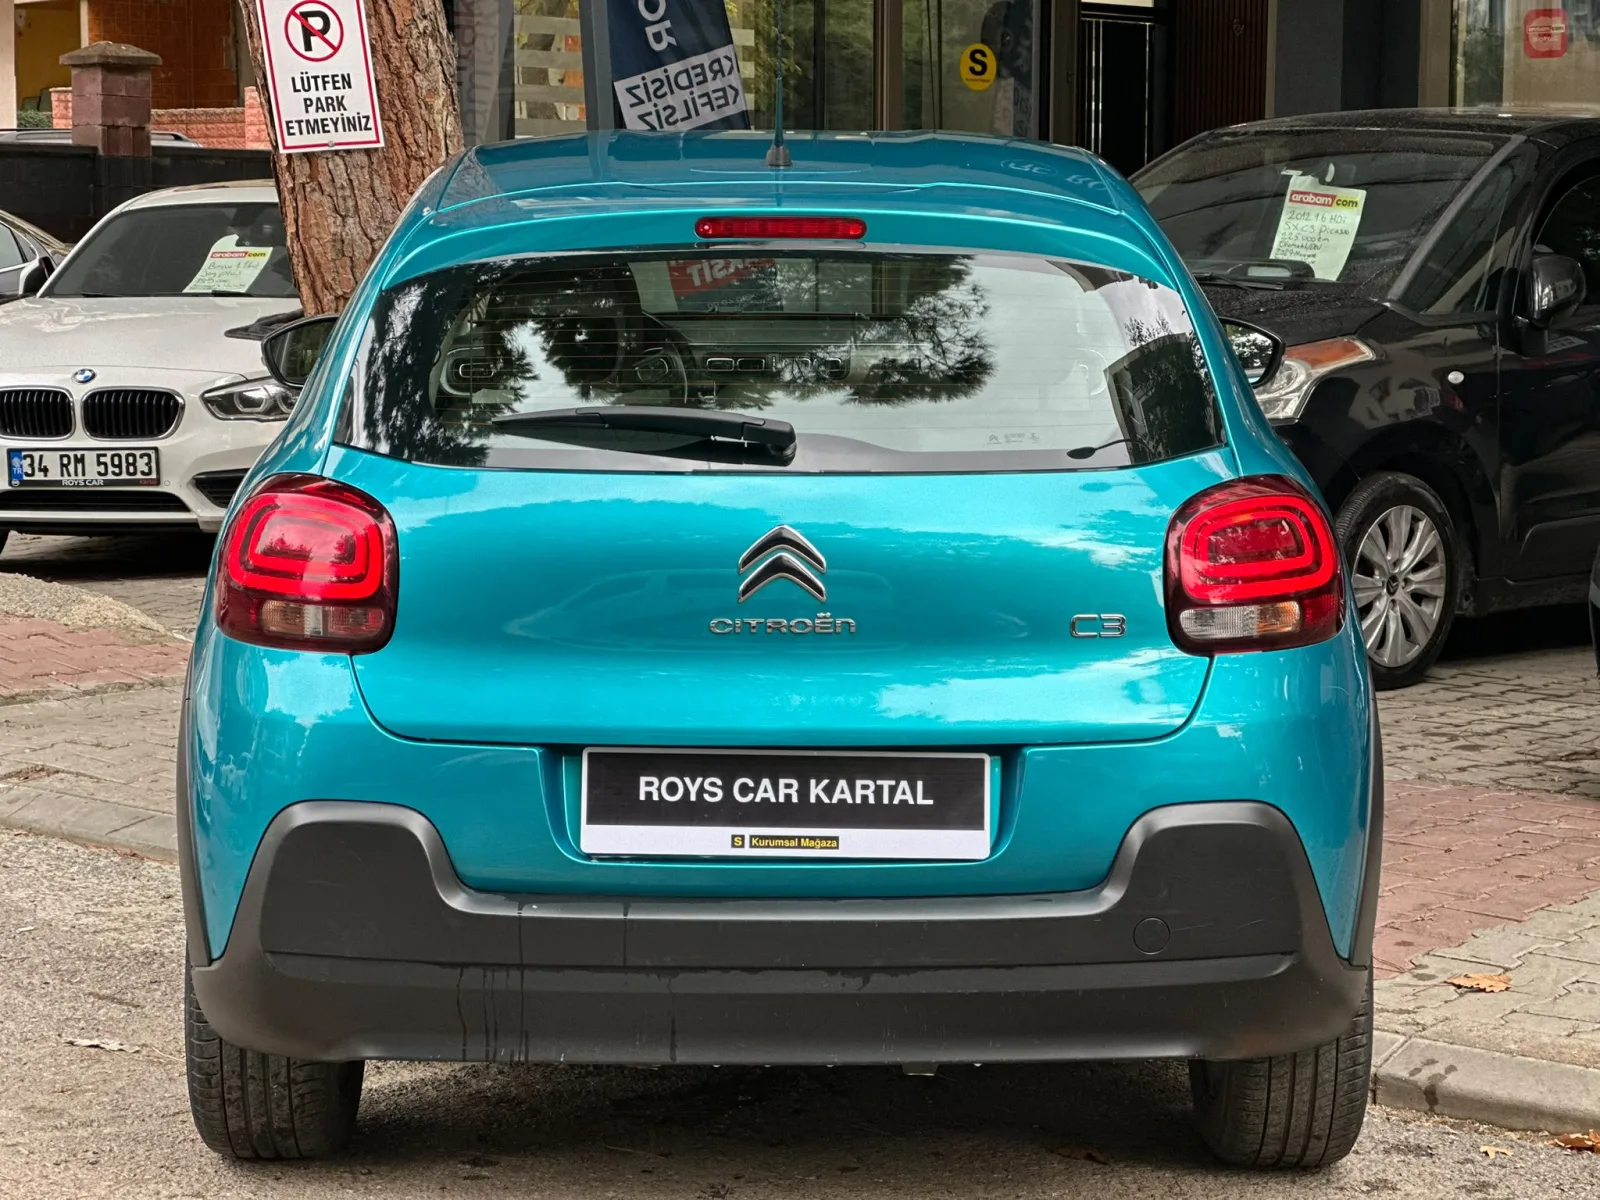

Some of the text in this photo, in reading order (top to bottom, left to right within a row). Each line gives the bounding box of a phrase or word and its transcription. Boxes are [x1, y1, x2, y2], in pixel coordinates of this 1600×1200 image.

[969, 48, 988, 76] S
[291, 71, 352, 93] LÜTFEN
[303, 95, 347, 114] PARK
[285, 112, 372, 136] ETMEYİNİZ
[23, 452, 153, 477] 34 RM 5983
[1070, 613, 1127, 638] C3
[639, 776, 934, 805] ROYS CAR KARTAL
[733, 836, 743, 846] S
[751, 837, 838, 849] Kurumsal Mağaza
